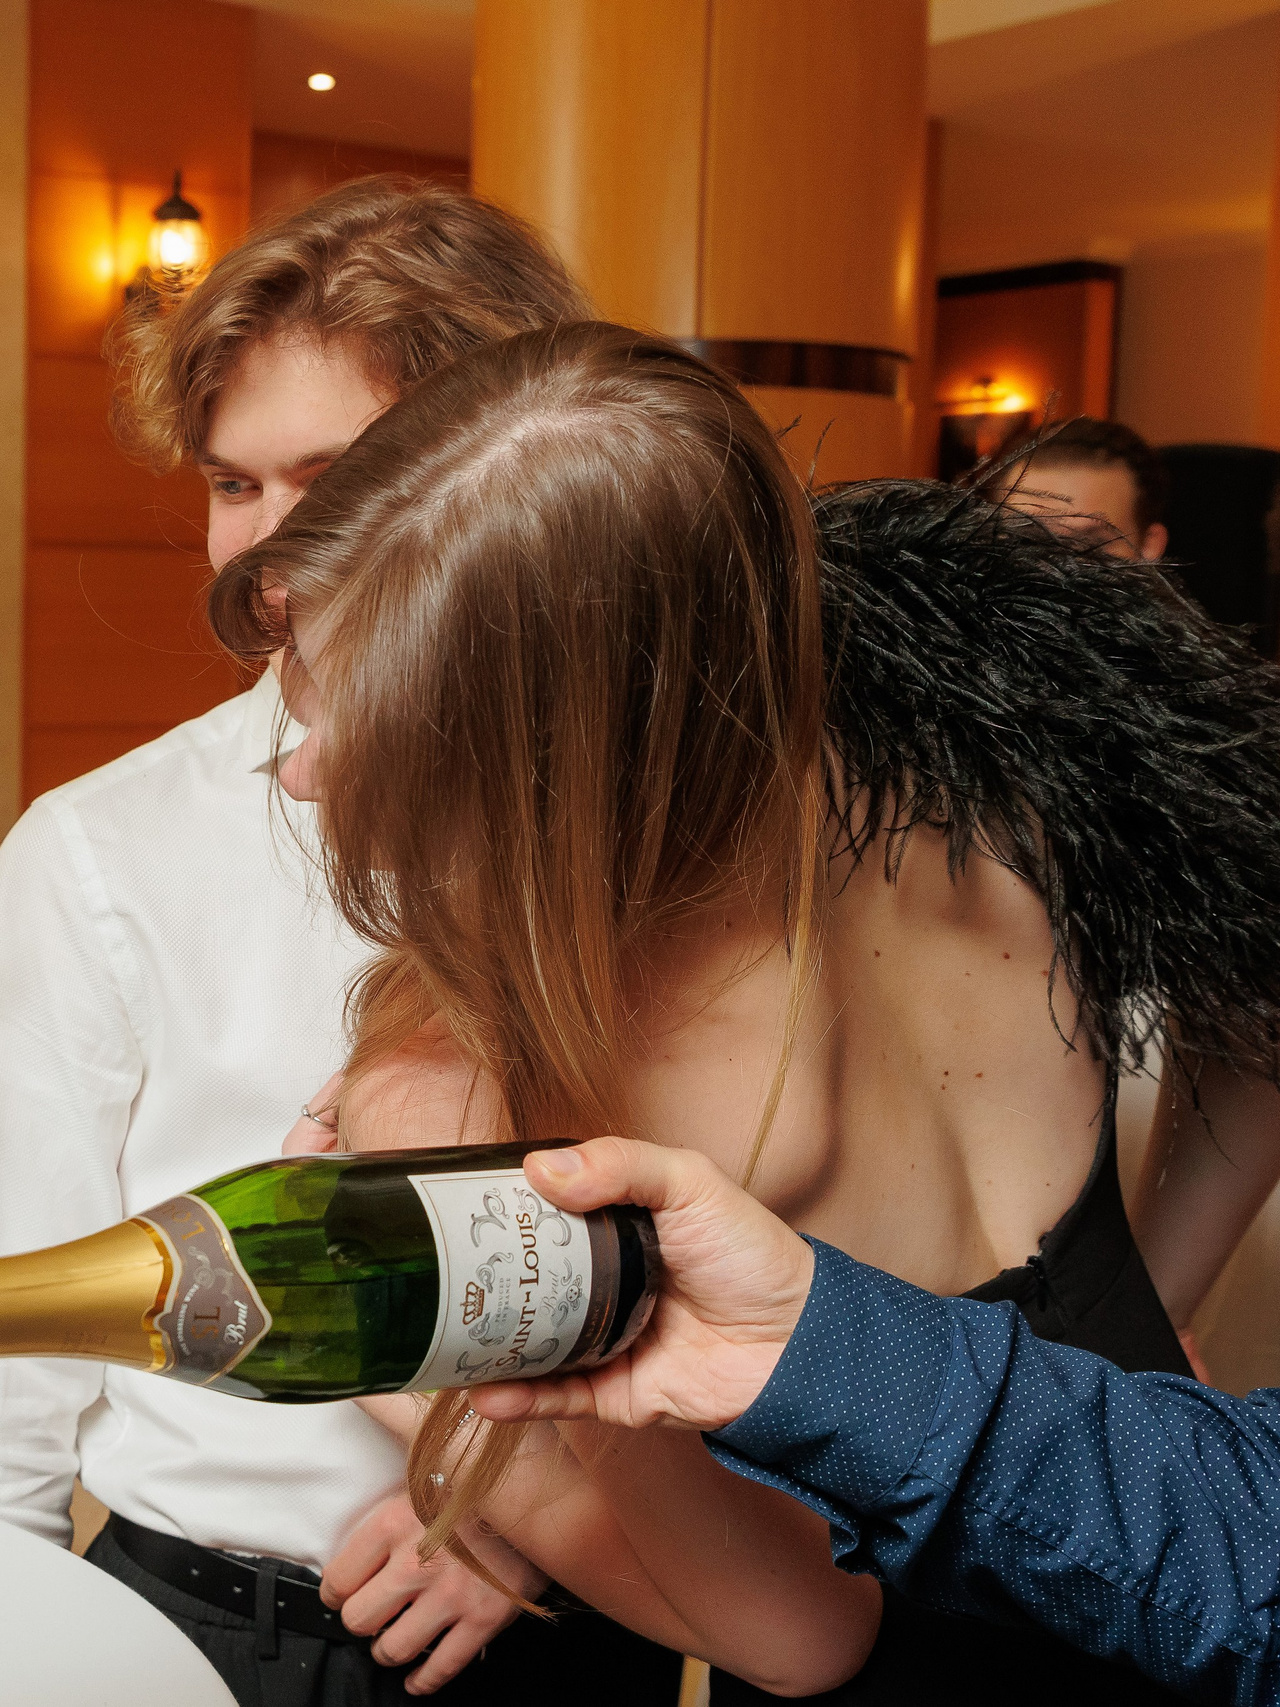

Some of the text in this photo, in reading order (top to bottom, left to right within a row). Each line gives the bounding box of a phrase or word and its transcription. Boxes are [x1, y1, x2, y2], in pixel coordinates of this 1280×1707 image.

[495, 1277, 505, 1323] PRODUCED
[501, 1277, 512, 1323] IN FRANCE
[539, 1269, 560, 1317] Brut
[223, 1300, 248, 1345] Brut
